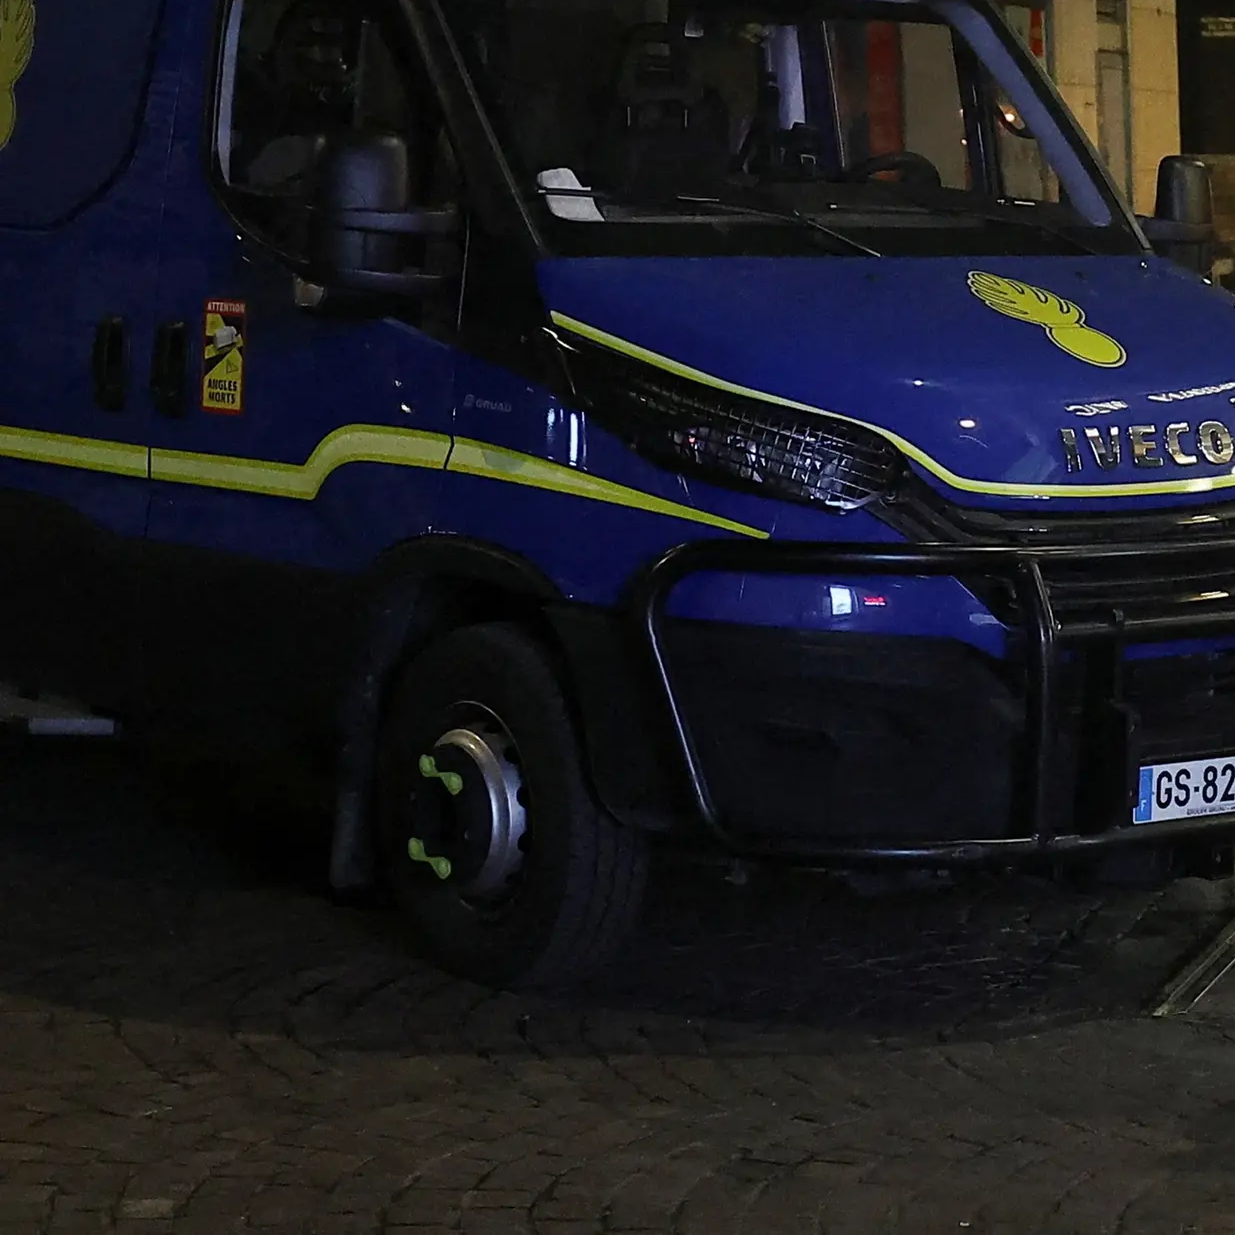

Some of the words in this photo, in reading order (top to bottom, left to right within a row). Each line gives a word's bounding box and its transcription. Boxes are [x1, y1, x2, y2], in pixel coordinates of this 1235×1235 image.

[207, 301, 245, 314] ATTENTION
[208, 378, 237, 392] ANGLES
[208, 391, 236, 405] MORTS
[1060, 420, 1235, 472] IVECO
